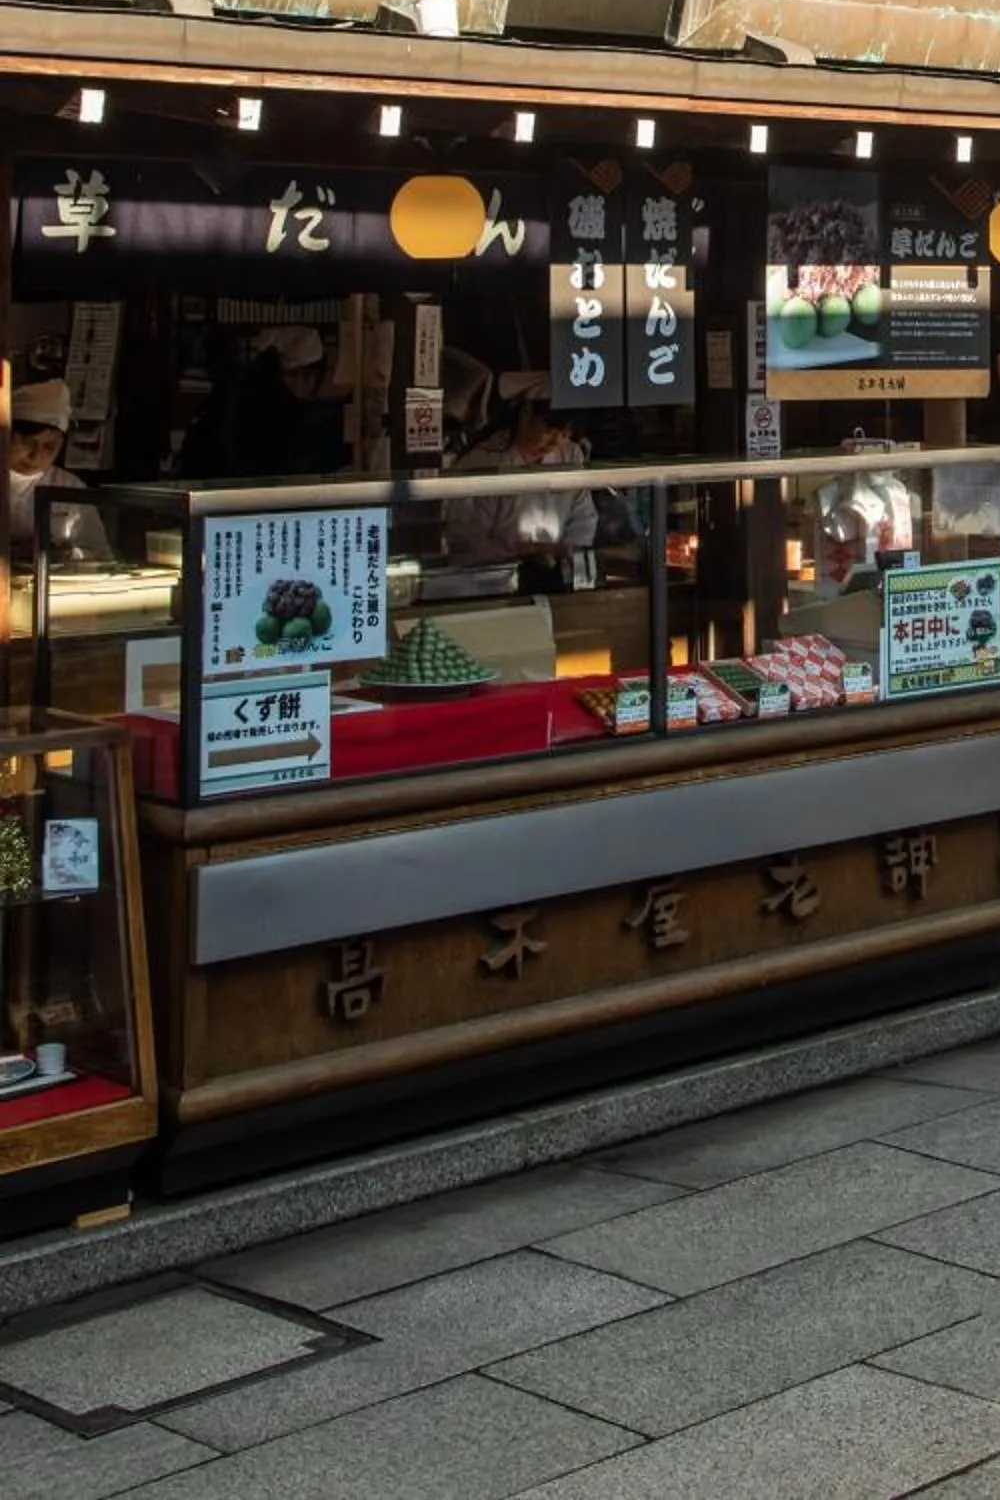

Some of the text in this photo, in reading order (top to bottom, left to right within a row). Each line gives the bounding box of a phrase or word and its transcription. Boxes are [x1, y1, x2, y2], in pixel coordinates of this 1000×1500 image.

[40, 167, 708, 255] 草だん
[890, 226, 980, 260] 草だんご
[641, 194, 680, 387] 焼だんご
[893, 615, 961, 645] 本日中に
[233, 691, 302, 724] くず餅
